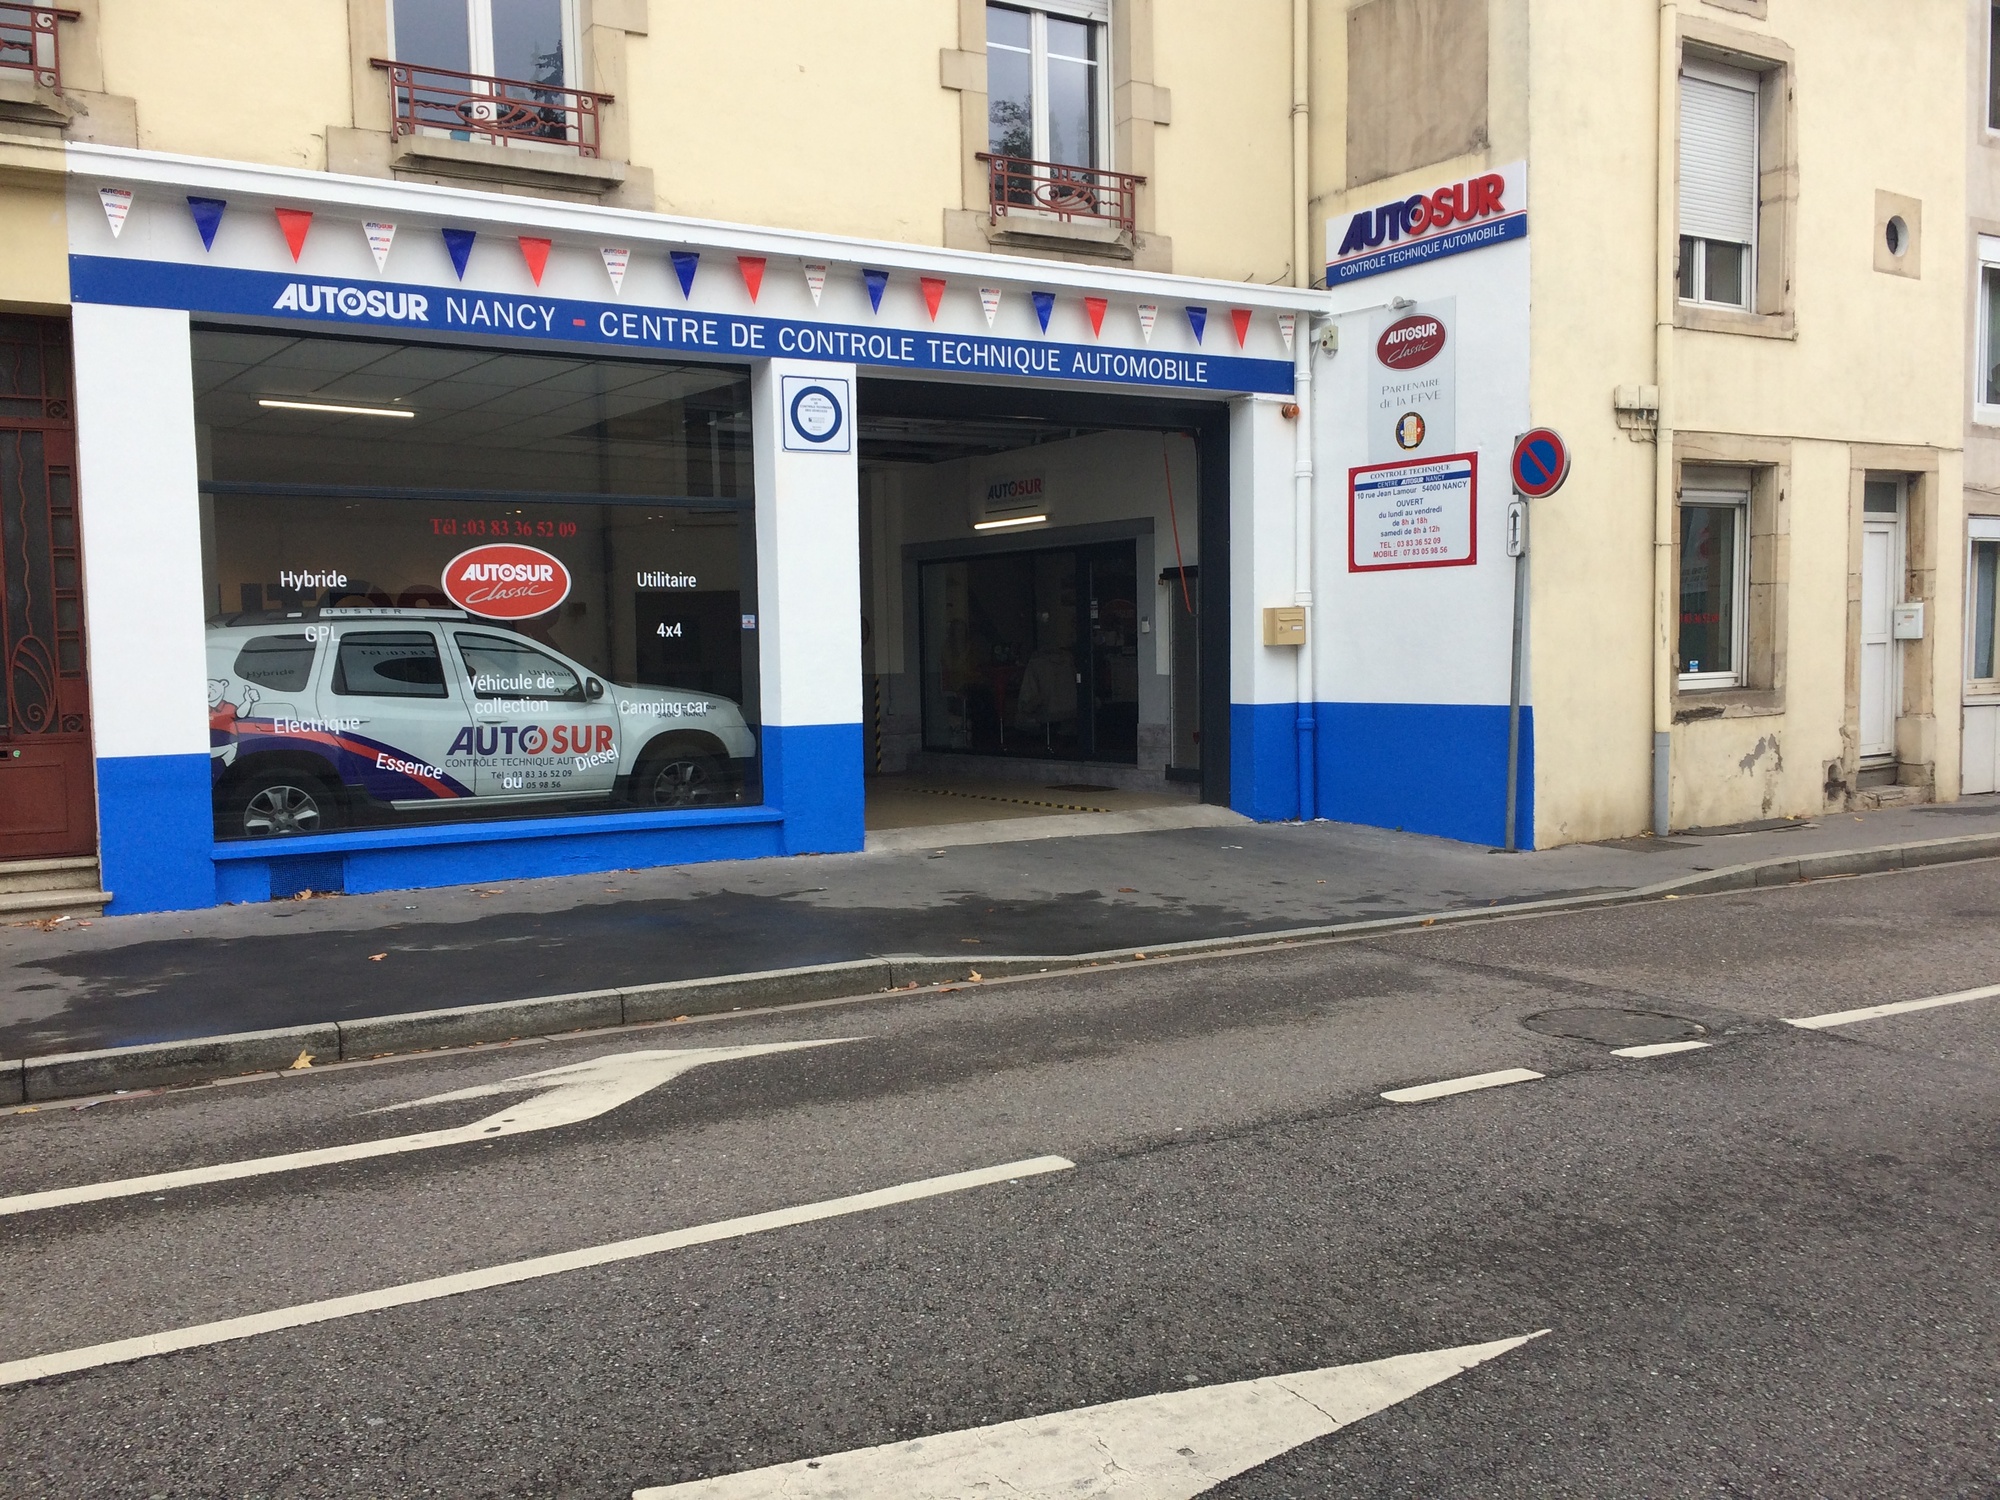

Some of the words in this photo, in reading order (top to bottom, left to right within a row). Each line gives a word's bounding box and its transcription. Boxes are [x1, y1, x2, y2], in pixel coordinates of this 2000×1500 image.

[1338, 173, 1505, 255] AUTOSUR
[1340, 254, 1386, 277] CONTROLE
[1388, 240, 1440, 264] TECHNIQUE
[1442, 223, 1505, 250] AUTOMOBILE
[273, 283, 429, 321] AUTOSUR
[446, 297, 556, 332] NANCY
[599, 311, 719, 346] CENTRE
[731, 322, 765, 350] DE
[778, 326, 915, 362] CONTROLE
[926, 339, 1061, 374] TECHNIQUE
[1072, 353, 1208, 383] AUTOMOBILE
[1385, 322, 1437, 346] AUTOSUR
[1370, 469, 1407, 480] CONTROLE
[1409, 464, 1451, 475] TECHNIQUE
[1425, 474, 1445, 482] NANCY
[987, 478, 1042, 500] AUTOSUR
[1393, 488, 1417, 496] Lamour
[1422, 483, 1441, 492] 54000
[1442, 481, 1467, 490] NANCY
[1378, 511, 1387, 519] du
[1388, 509, 1404, 518] lundi
[1414, 505, 1442, 515] vendredi
[1396, 498, 1424, 508] OUVERT
[430, 518, 457, 535] Tél
[491, 520, 509, 536] 83
[514, 521, 532, 537] 36
[537, 521, 554, 537] 52
[559, 522, 576, 537] 09
[1401, 518, 1409, 526] 8h
[1416, 517, 1428, 525] 18h
[1380, 528, 1403, 537] samedi
[1404, 527, 1412, 535] de
[1373, 550, 1398, 558] MOBILE
[1421, 547, 1429, 555] 05
[1380, 541, 1392, 549] TEL
[1406, 539, 1414, 547] 83
[1414, 538, 1423, 546] 36
[280, 570, 347, 591] Hybride
[460, 563, 553, 582] AUTOSUR
[637, 571, 697, 588] Utilitaire
[304, 625, 341, 643] GPL
[656, 622, 682, 638] 4x4
[467, 674, 533, 692] Véhicule
[537, 674, 555, 690] de
[474, 697, 549, 715] collection
[619, 698, 709, 718] Camping-car
[273, 715, 360, 734] Electrique
[446, 725, 613, 756] AUTOSUR
[375, 752, 444, 780] Essence
[445, 756, 498, 768] CONTRÔLE
[501, 757, 554, 767] TECHNIQUE
[575, 743, 619, 772] Diesel
[562, 769, 572, 777] 09
[503, 777, 523, 789] ou
